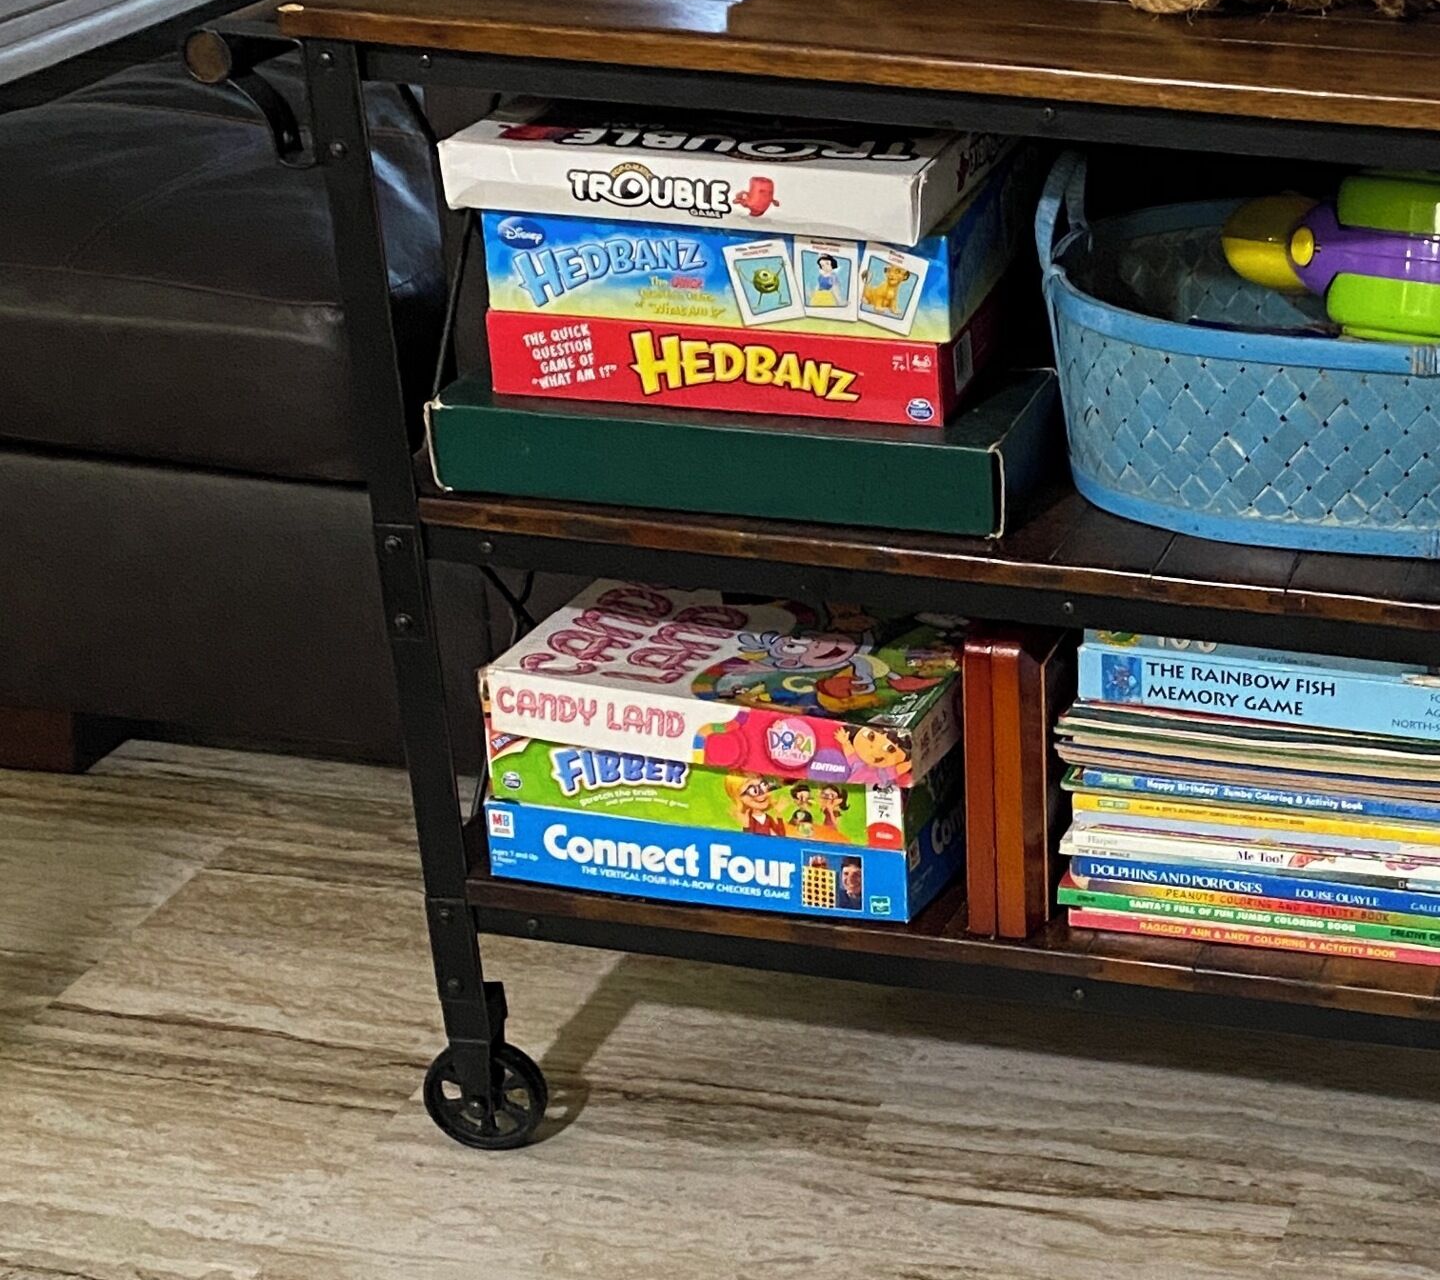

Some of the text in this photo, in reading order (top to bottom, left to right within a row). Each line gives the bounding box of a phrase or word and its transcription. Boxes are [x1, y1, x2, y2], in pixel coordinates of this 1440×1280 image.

[568, 169, 731, 214] TROUBLE
[689, 208, 723, 219] GAME
[503, 225, 543, 243] Disney
[513, 239, 707, 308] HEDBANZ
[522, 323, 591, 347] THE QUICK
[532, 337, 592, 361] QUESTION
[540, 352, 594, 374] GAME OF
[576, 368, 596, 383] AM
[629, 330, 861, 402] HEDBANZ
[1147, 662, 1336, 696] THE RAINBOW FISH
[496, 686, 686, 739] CANDY LAND
[1148, 684, 1303, 716] MEMORY GAME
[769, 730, 812, 754] DORA
[553, 748, 687, 794] FIBBER
[810, 761, 846, 773] EDITION
[1146, 779, 1175, 792] Happy
[1178, 783, 1218, 796] Birthday!
[1223, 788, 1253, 799] Jumbo
[1255, 792, 1294, 805] Coloring
[1295, 796, 1302, 804] &
[1305, 797, 1339, 809] Activity
[1340, 800, 1363, 810] Book
[492, 814, 510, 826] MB
[543, 823, 795, 888] Connect Four
[1237, 851, 1284, 863] Me Too!
[581, 865, 791, 900] THE VERTICAL FOUR-IN-A-ROW CHECKERS GAME
[1090, 863, 1263, 894] DOLPHINS AND PORPOISES
[1165, 888, 1390, 922] PEANUTS COLORING AND ACTIVITY BOOK
[1295, 888, 1335, 902] LOUISE
[1129, 900, 1356, 932] SANTA'S FULL OF FUN JUMBO COLORING BOOK
[1139, 921, 1187, 935] RAGGEDY
[1190, 927, 1212, 937] ANN
[1224, 931, 1251, 942] ANDY
[1253, 935, 1307, 950] COLORING
[1309, 941, 1316, 950] &
[1319, 943, 1364, 955] ACTIVITY
[1366, 948, 1397, 959] BOOK
[1390, 929, 1426, 940] CREATIVE
